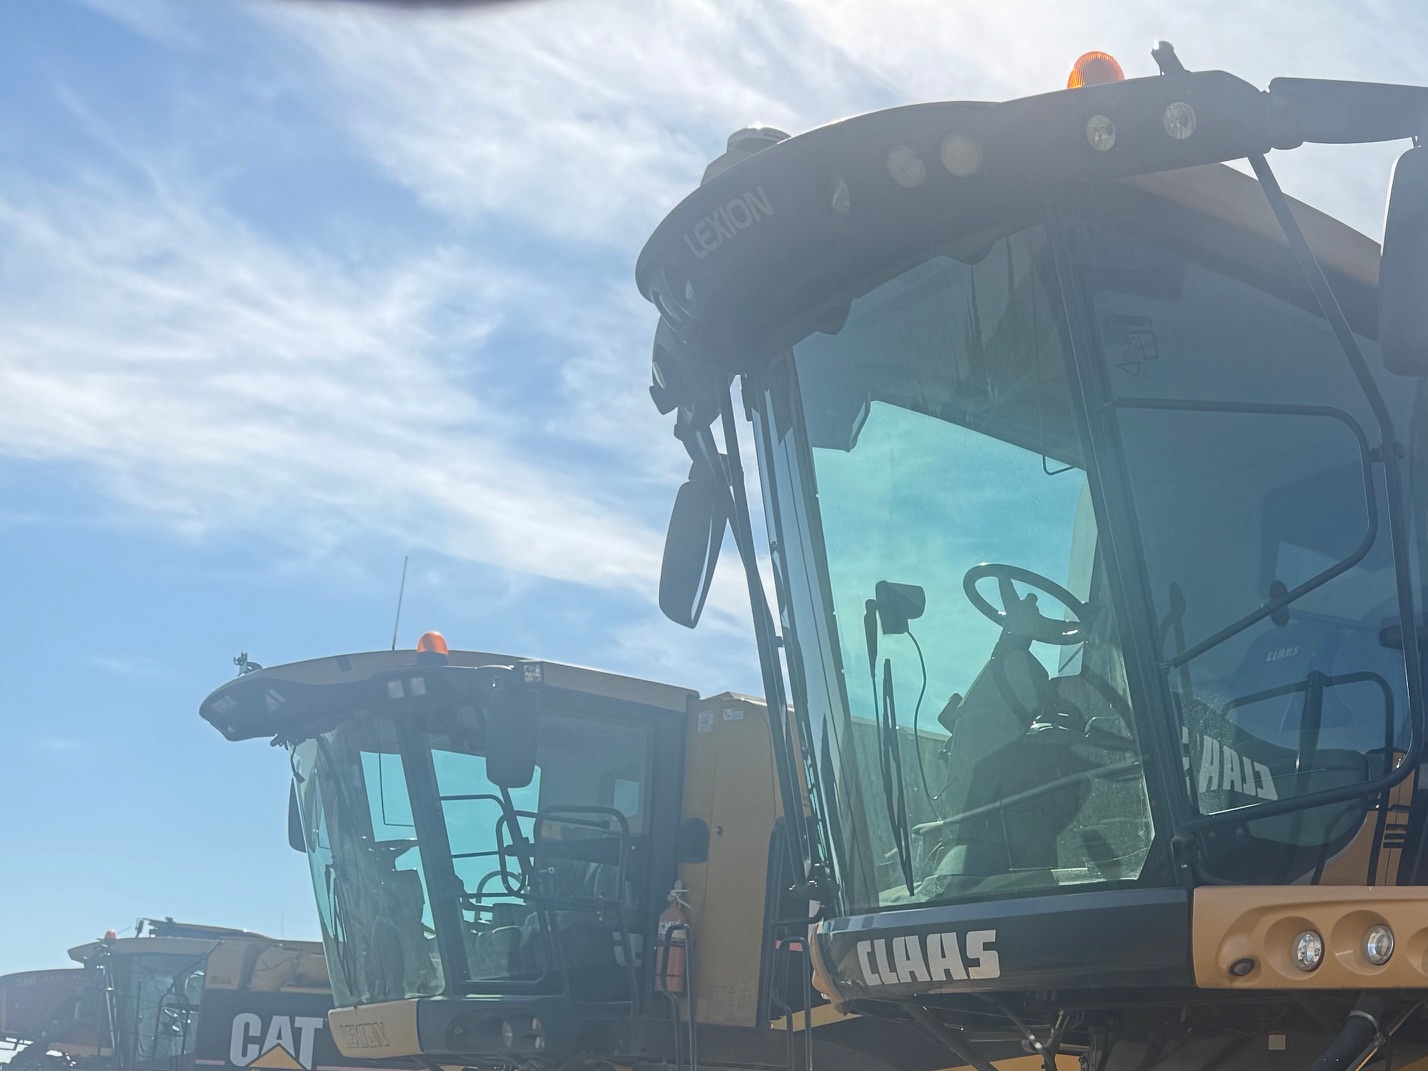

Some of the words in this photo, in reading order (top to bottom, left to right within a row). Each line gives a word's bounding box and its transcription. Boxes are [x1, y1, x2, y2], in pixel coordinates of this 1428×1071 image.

[683, 185, 776, 260] LEXION
[856, 929, 1001, 986] CLAAS
[229, 1012, 324, 1071] CAT
